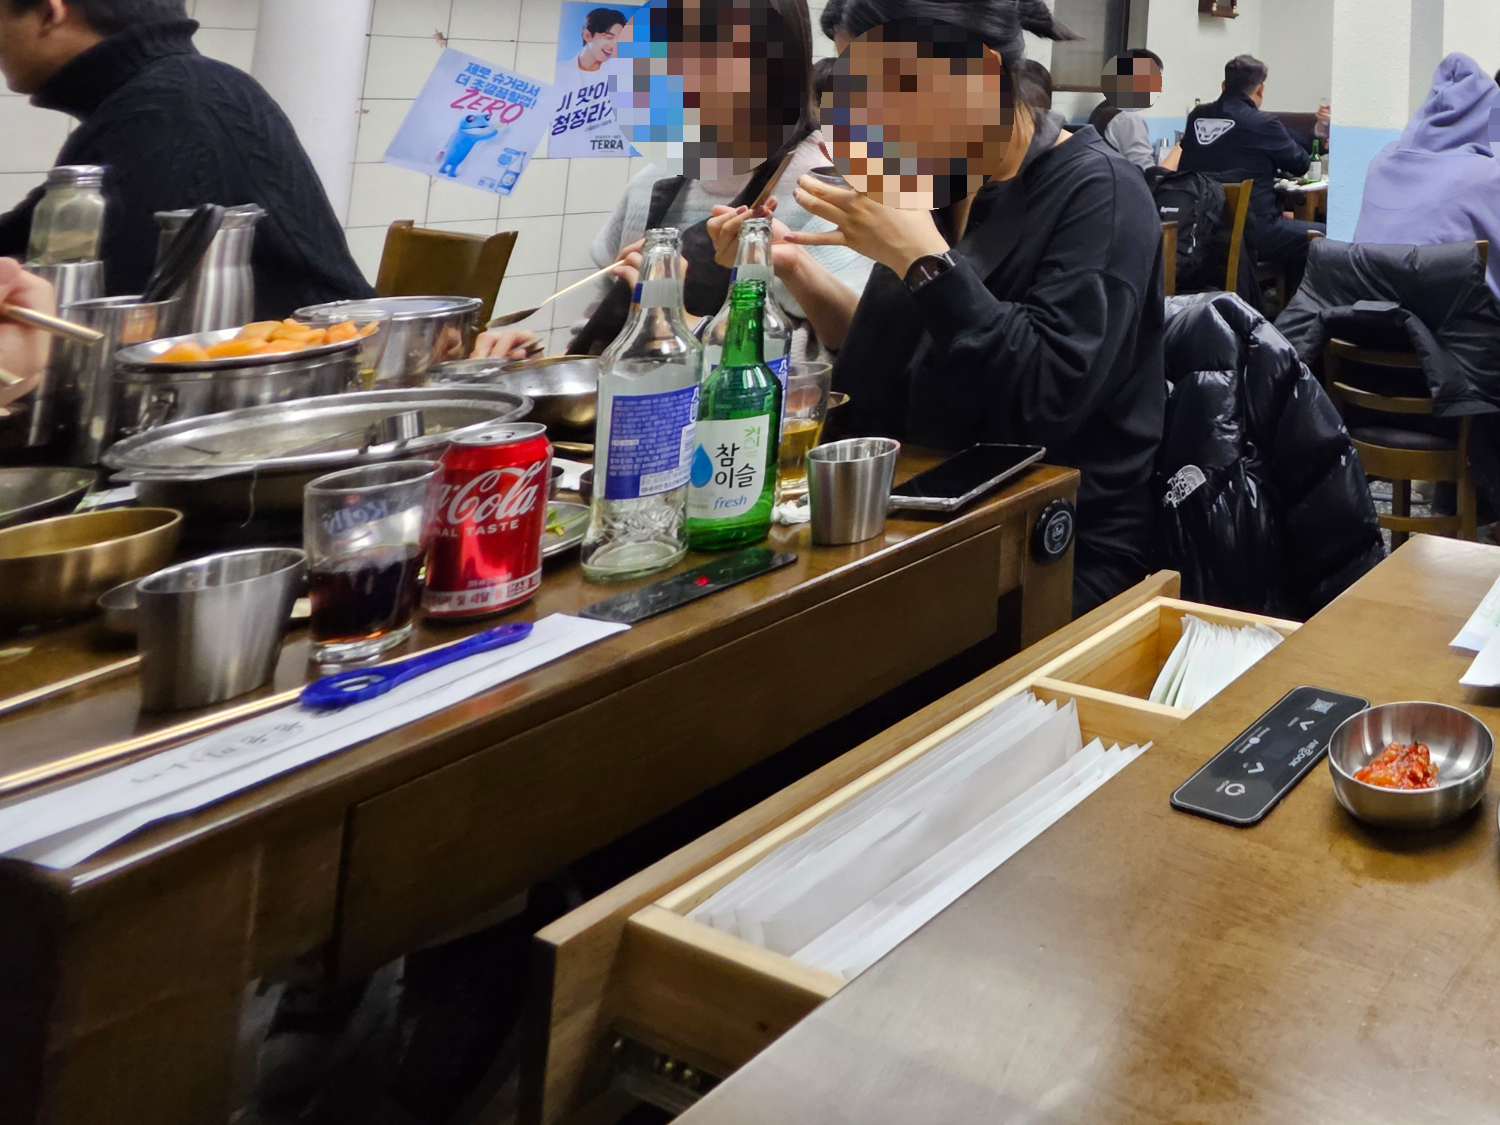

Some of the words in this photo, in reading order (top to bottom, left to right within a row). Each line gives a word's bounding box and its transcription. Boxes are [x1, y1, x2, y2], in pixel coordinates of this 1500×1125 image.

[455, 73, 471, 87] 더
[464, 62, 492, 80] 제로
[492, 73, 541, 98] 슈거라서
[449, 88, 525, 124] ZERO
[590, 139, 624, 151] TERRA
[715, 442, 740, 467] 참
[714, 463, 757, 489] 이슬
[1167, 470, 1185, 488] THE
[713, 494, 748, 511] fresh
[465, 519, 520, 536] TASTE
